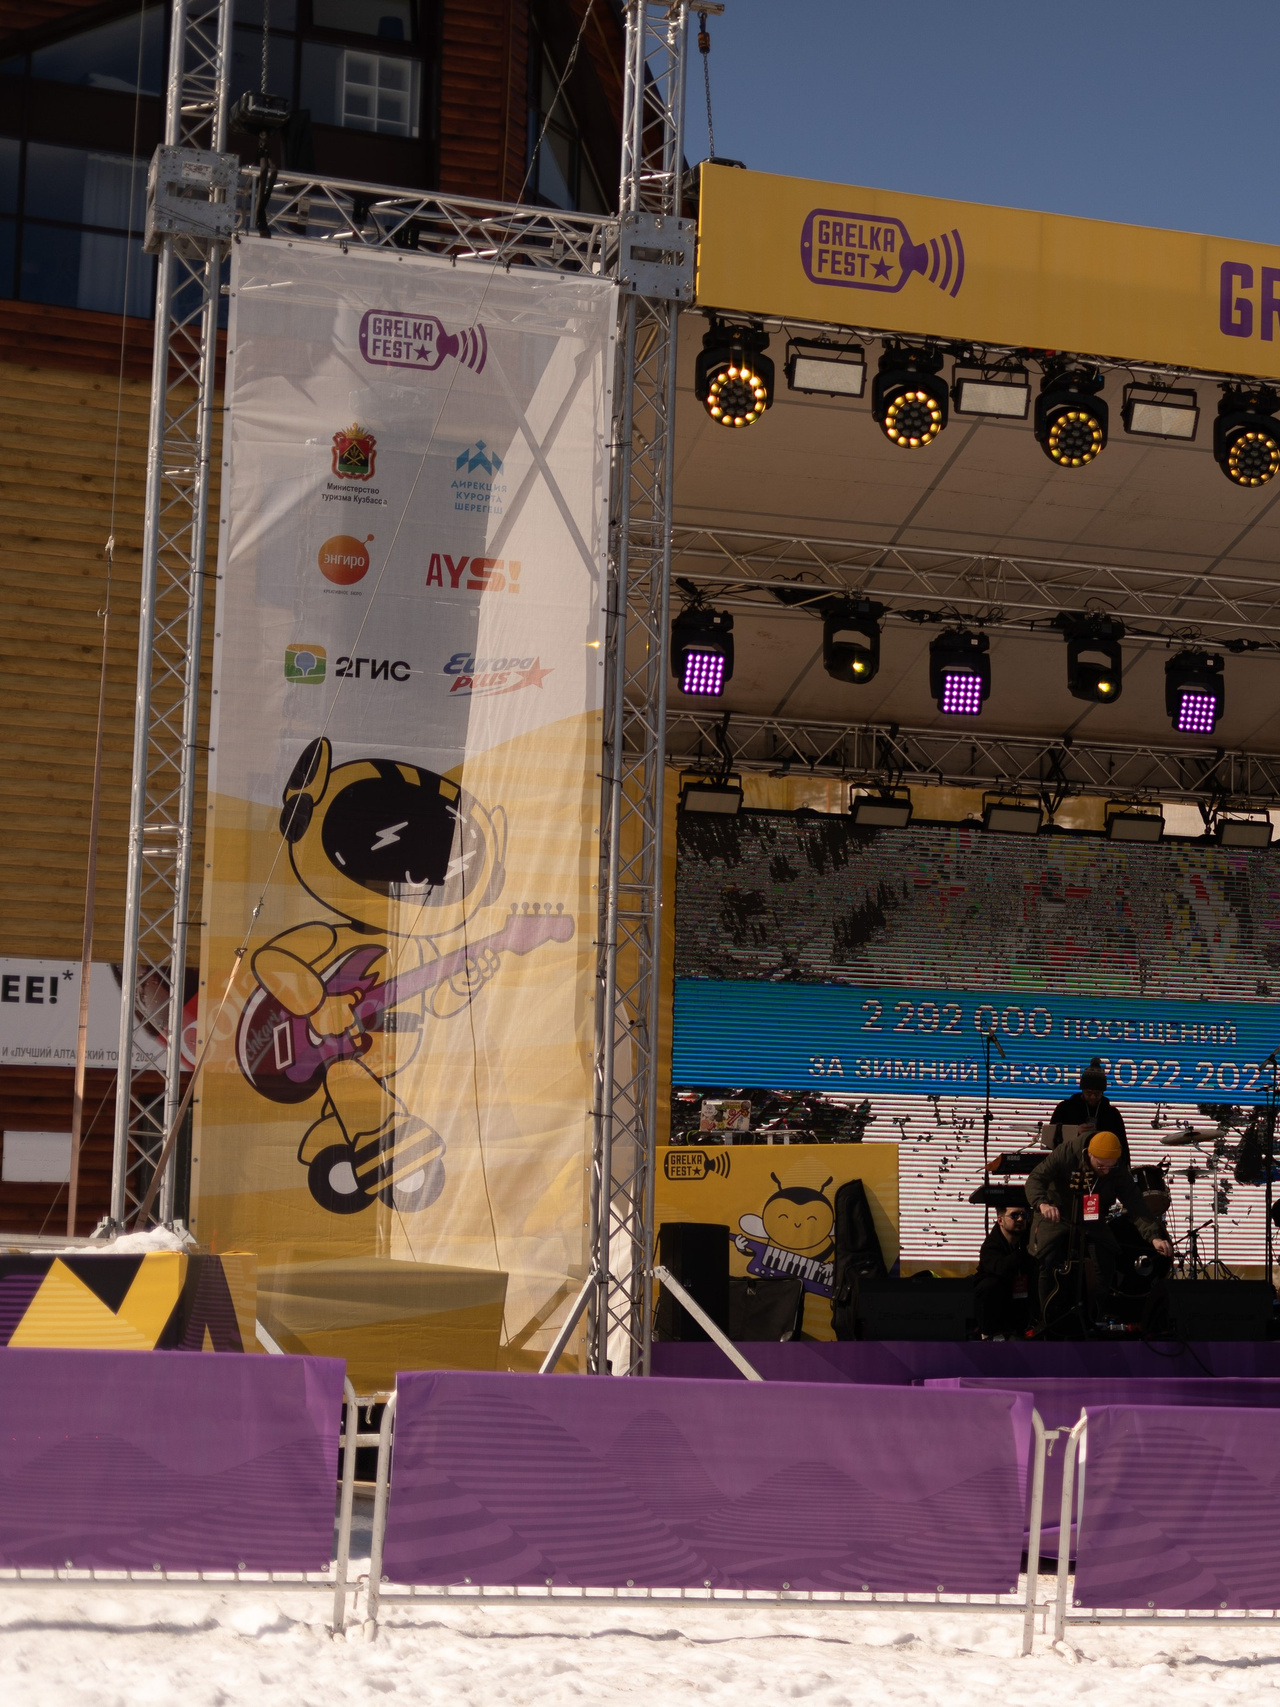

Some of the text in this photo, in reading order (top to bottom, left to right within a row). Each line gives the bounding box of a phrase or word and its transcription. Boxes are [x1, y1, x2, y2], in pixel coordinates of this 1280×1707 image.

[818, 220, 895, 252] GRELKA
[817, 248, 870, 277] FEST
[372, 317, 433, 341] GRELKA
[372, 338, 413, 360] FEST
[326, 482, 380, 495] Министерство
[451, 480, 507, 493] ДИРЕКЦИЯ
[321, 493, 388, 506] туризма Кузбасса
[456, 491, 502, 503] КУРОРТА
[454, 502, 503, 514] ШЕРЕГЕШ
[324, 553, 365, 569] энгиро
[425, 553, 521, 593] AYS!
[335, 656, 411, 682] 2ГИС
[443, 652, 533, 675] Europa
[860, 999, 1237, 1046] 2 292 000 ПОСЕЩЕНИЙ
[54, 1048, 104, 1061] АЛТАКИЙ
[808, 1055, 844, 1078] ЗА
[854, 1056, 978, 1083] ЗИМНИЙ
[989, 1061, 1081, 1086] СЕЗОН
[670, 1154, 702, 1166] GRELKA
[670, 1165, 692, 1177] FEST
